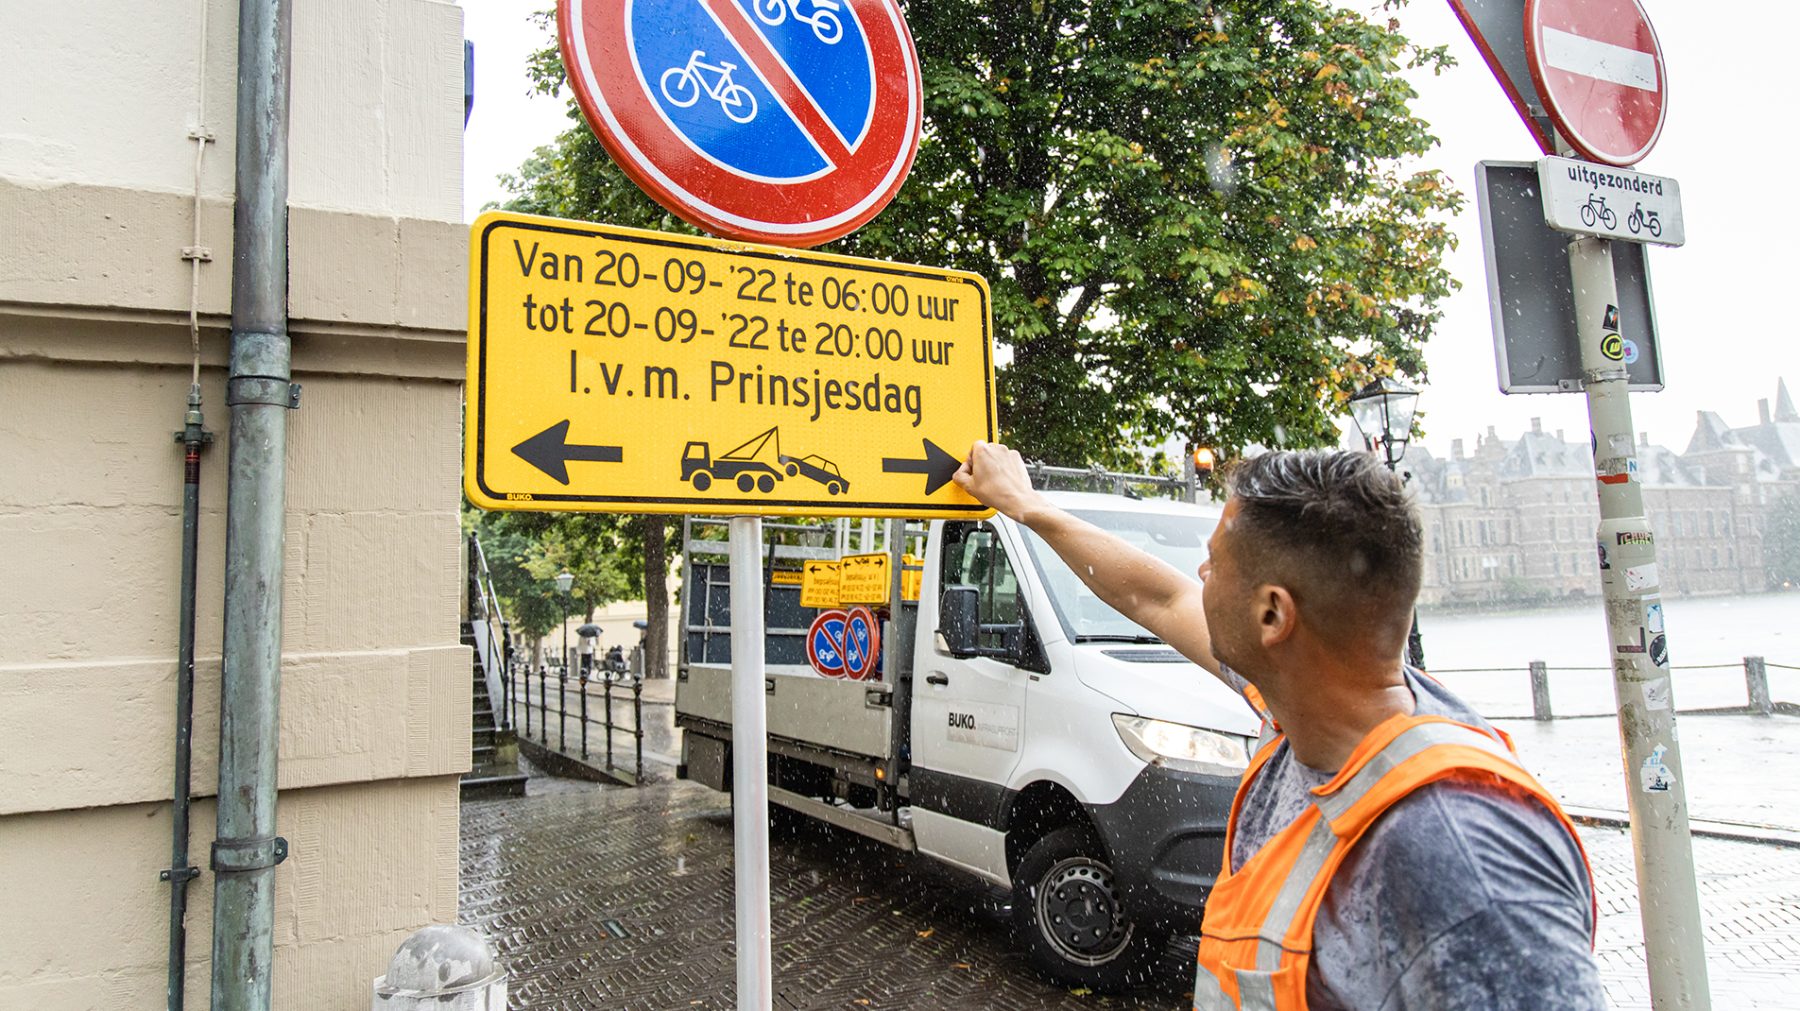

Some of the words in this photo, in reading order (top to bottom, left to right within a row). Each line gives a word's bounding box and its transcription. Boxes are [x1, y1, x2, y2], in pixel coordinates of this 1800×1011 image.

[1567, 165, 1664, 197] uitgezonderd
[513, 239, 583, 283] Van
[594, 249, 777, 303] 20-09-'22
[784, 272, 814, 306] te
[822, 276, 909, 317] 06:00
[917, 294, 960, 322] uur
[522, 293, 575, 334] tot
[584, 299, 769, 351] 20-09-'22
[776, 318, 807, 353] te
[815, 321, 904, 362] 20:00
[912, 338, 955, 366] uur
[710, 360, 922, 428] Prinsjesdag
